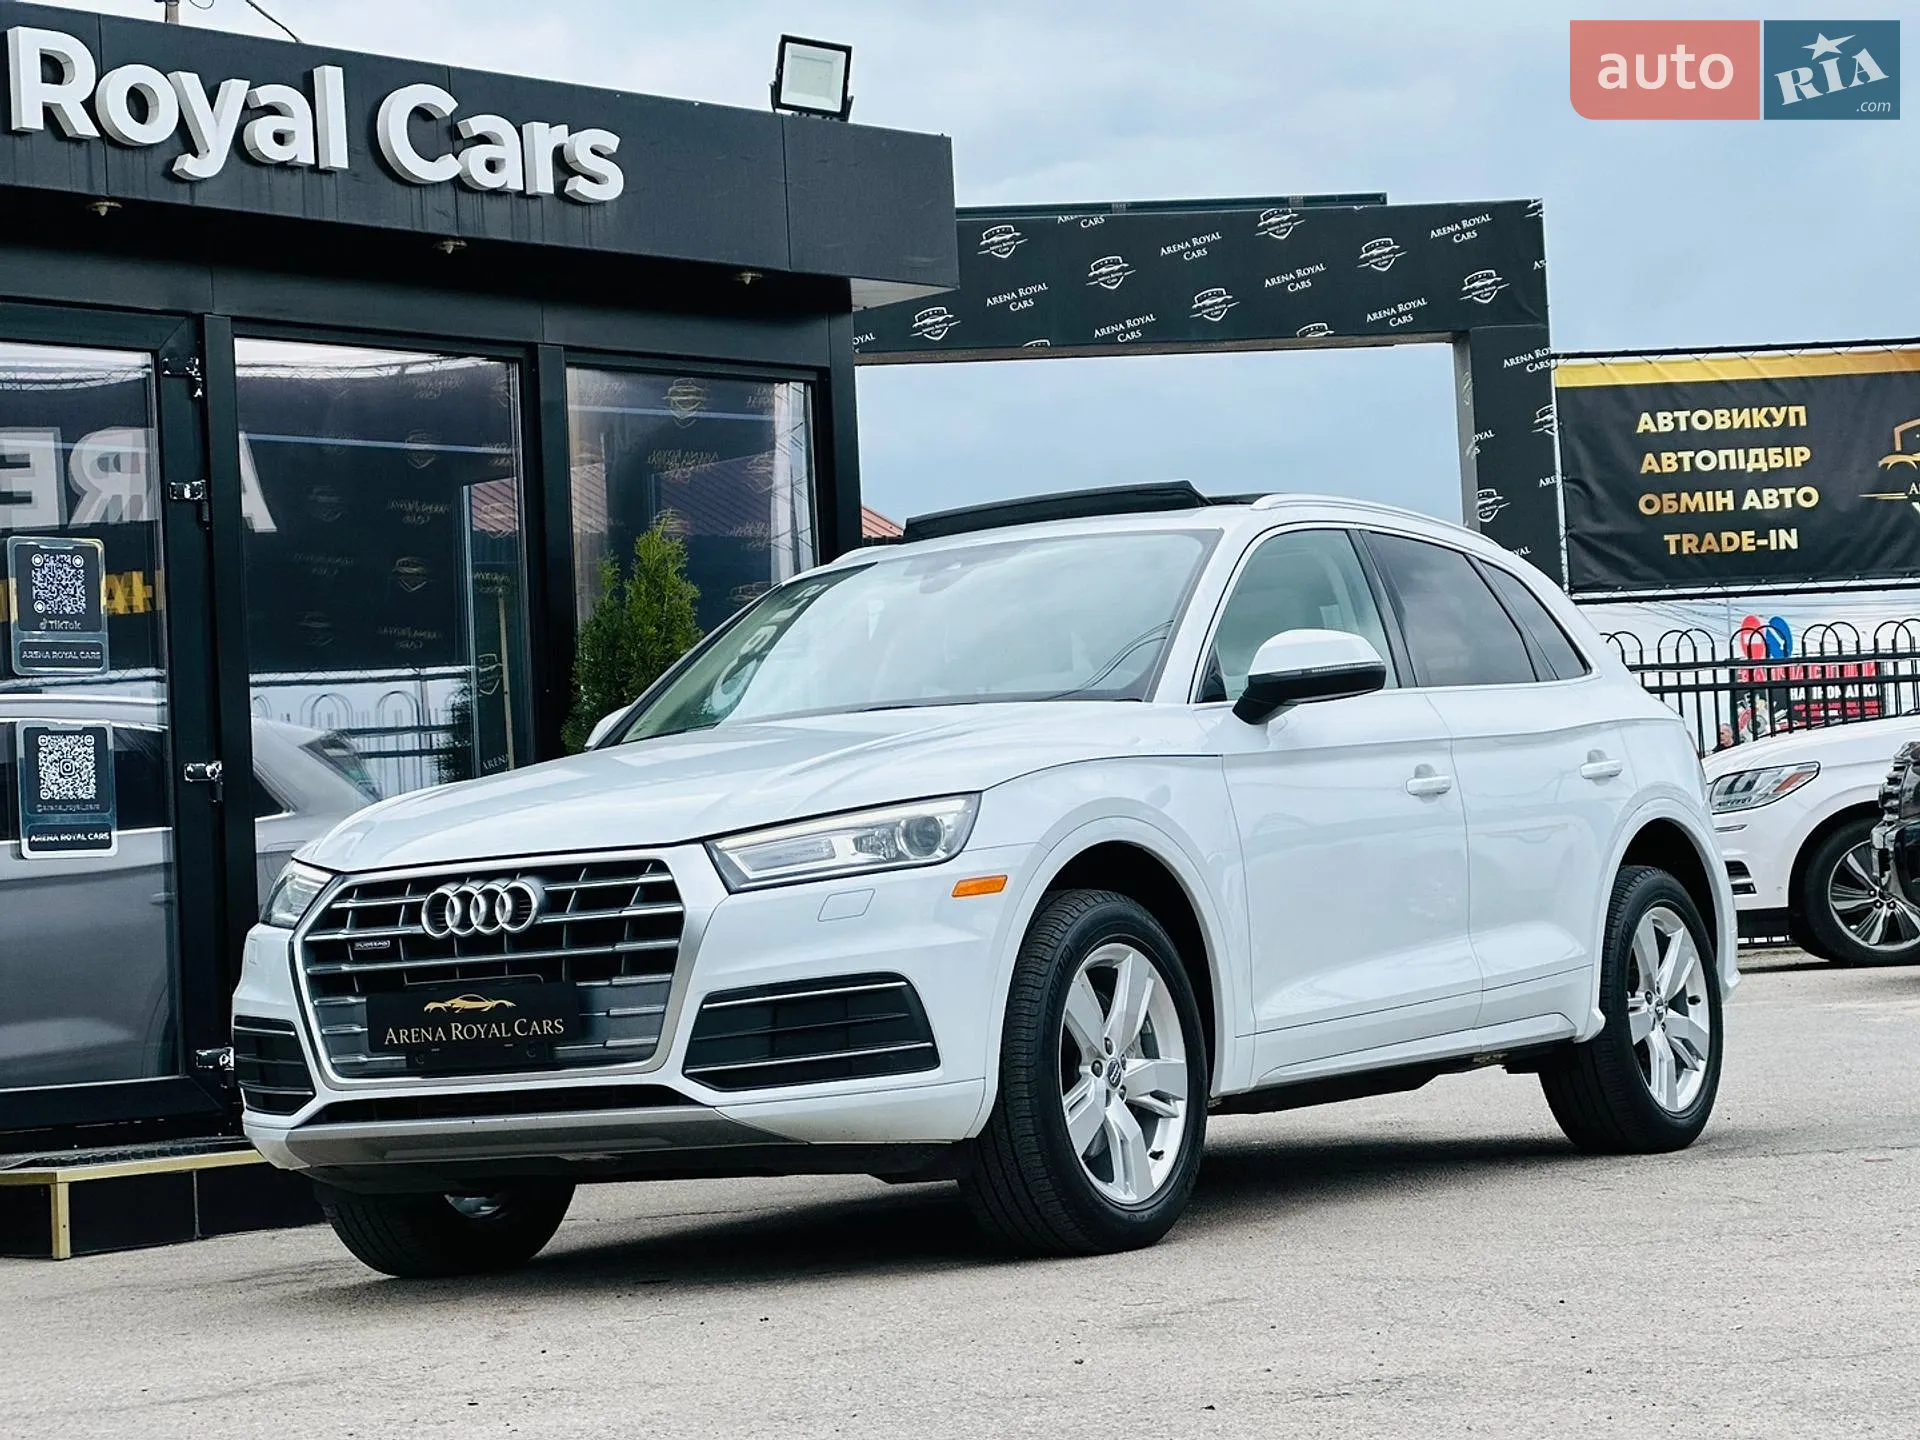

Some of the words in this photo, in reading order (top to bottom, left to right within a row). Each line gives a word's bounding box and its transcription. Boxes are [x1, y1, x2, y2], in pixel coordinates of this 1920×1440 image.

[6, 25, 349, 181] Royal
[376, 83, 625, 203] Cars
[1636, 405, 1808, 434] АВТОВИКУП
[1640, 446, 1811, 474] АВТОПІДБІР
[1638, 489, 1735, 515] ОБМІН
[1741, 485, 1820, 512] АВТО
[1663, 528, 1799, 555] TRADE-IN
[52, 650, 79, 660] ROYAL
[79, 651, 102, 660] CARS
[87, 831, 110, 841] CARS
[384, 1026, 447, 1045] ARENA
[450, 1022, 512, 1041] ROYAL
[514, 1018, 565, 1037] CARS
